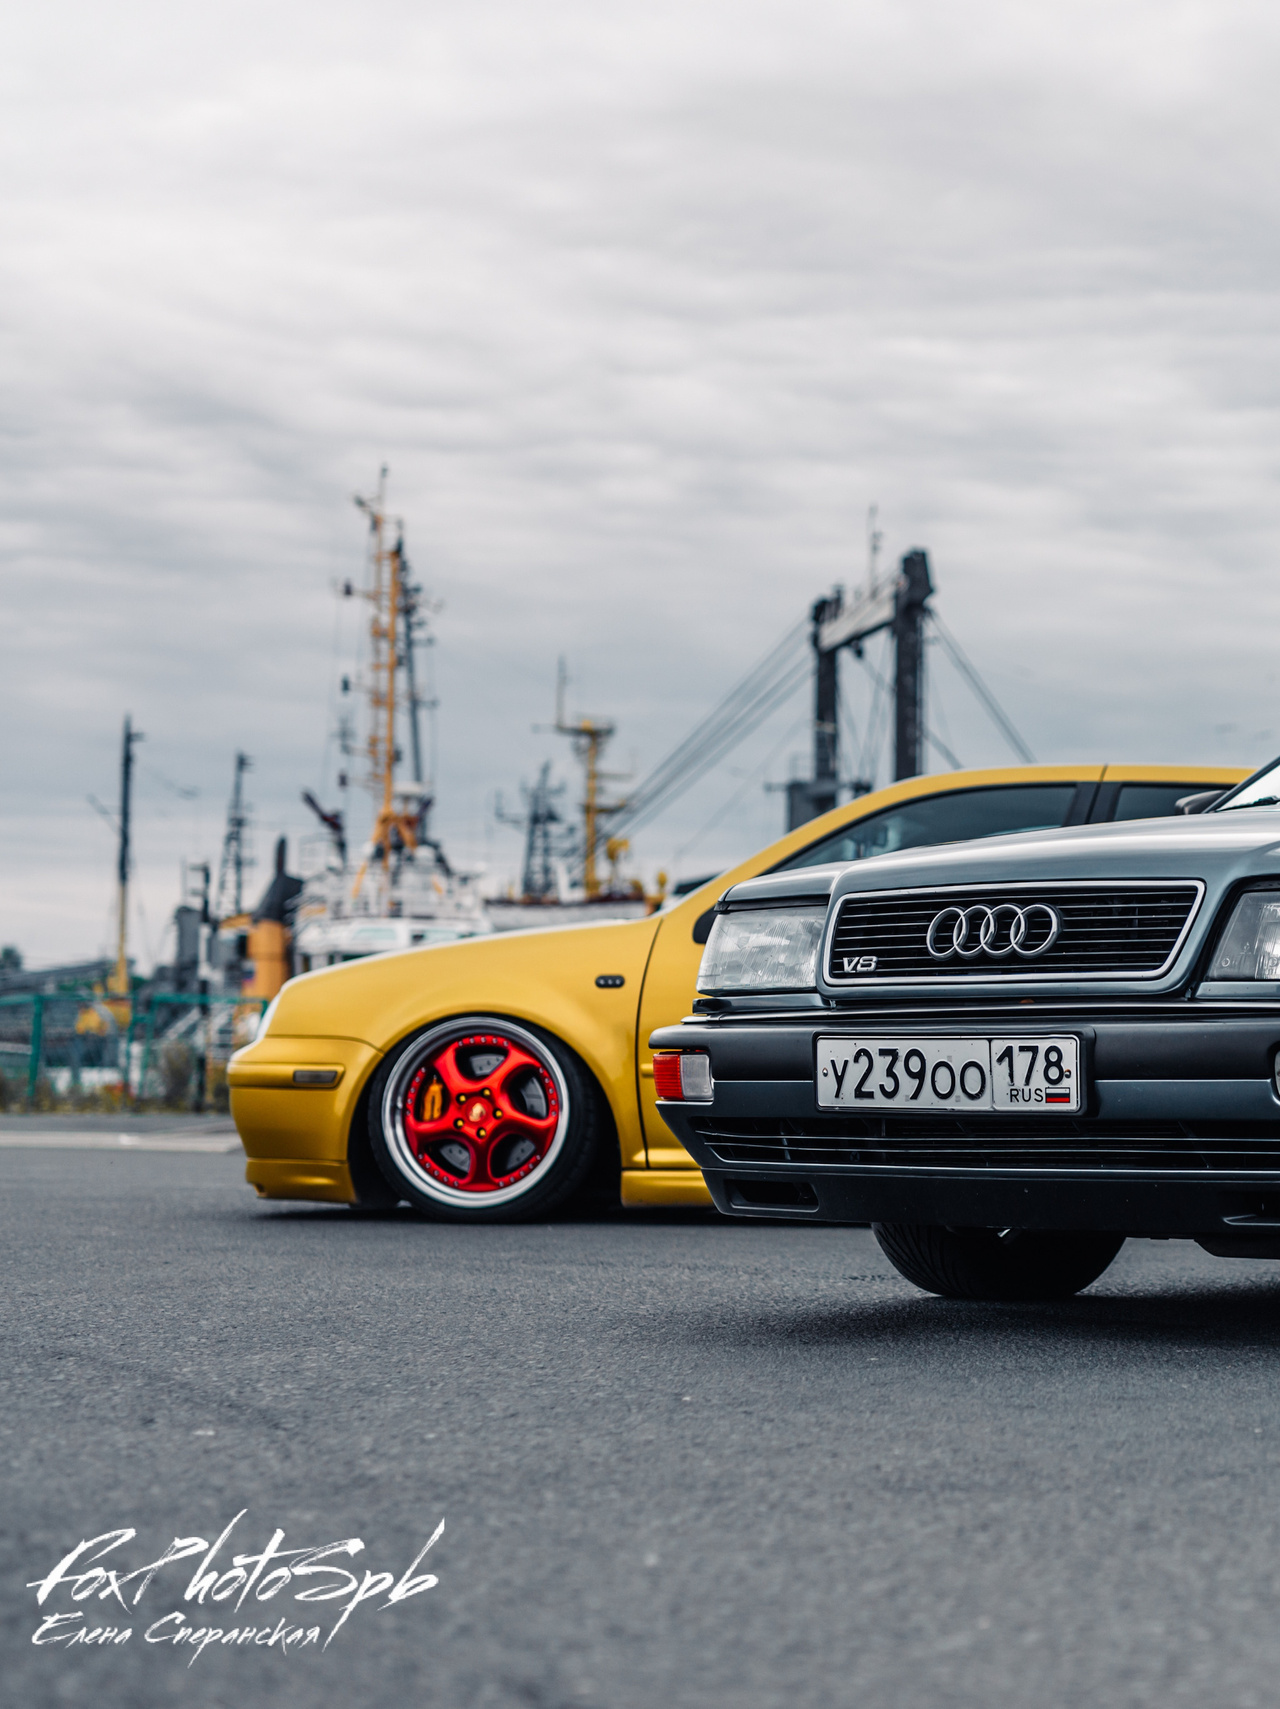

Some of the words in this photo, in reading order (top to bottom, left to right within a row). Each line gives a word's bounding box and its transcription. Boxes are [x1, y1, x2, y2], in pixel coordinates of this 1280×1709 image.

[842, 955, 879, 974] V8
[995, 1044, 1066, 1087] 178
[1009, 1088, 1044, 1103] RUS
